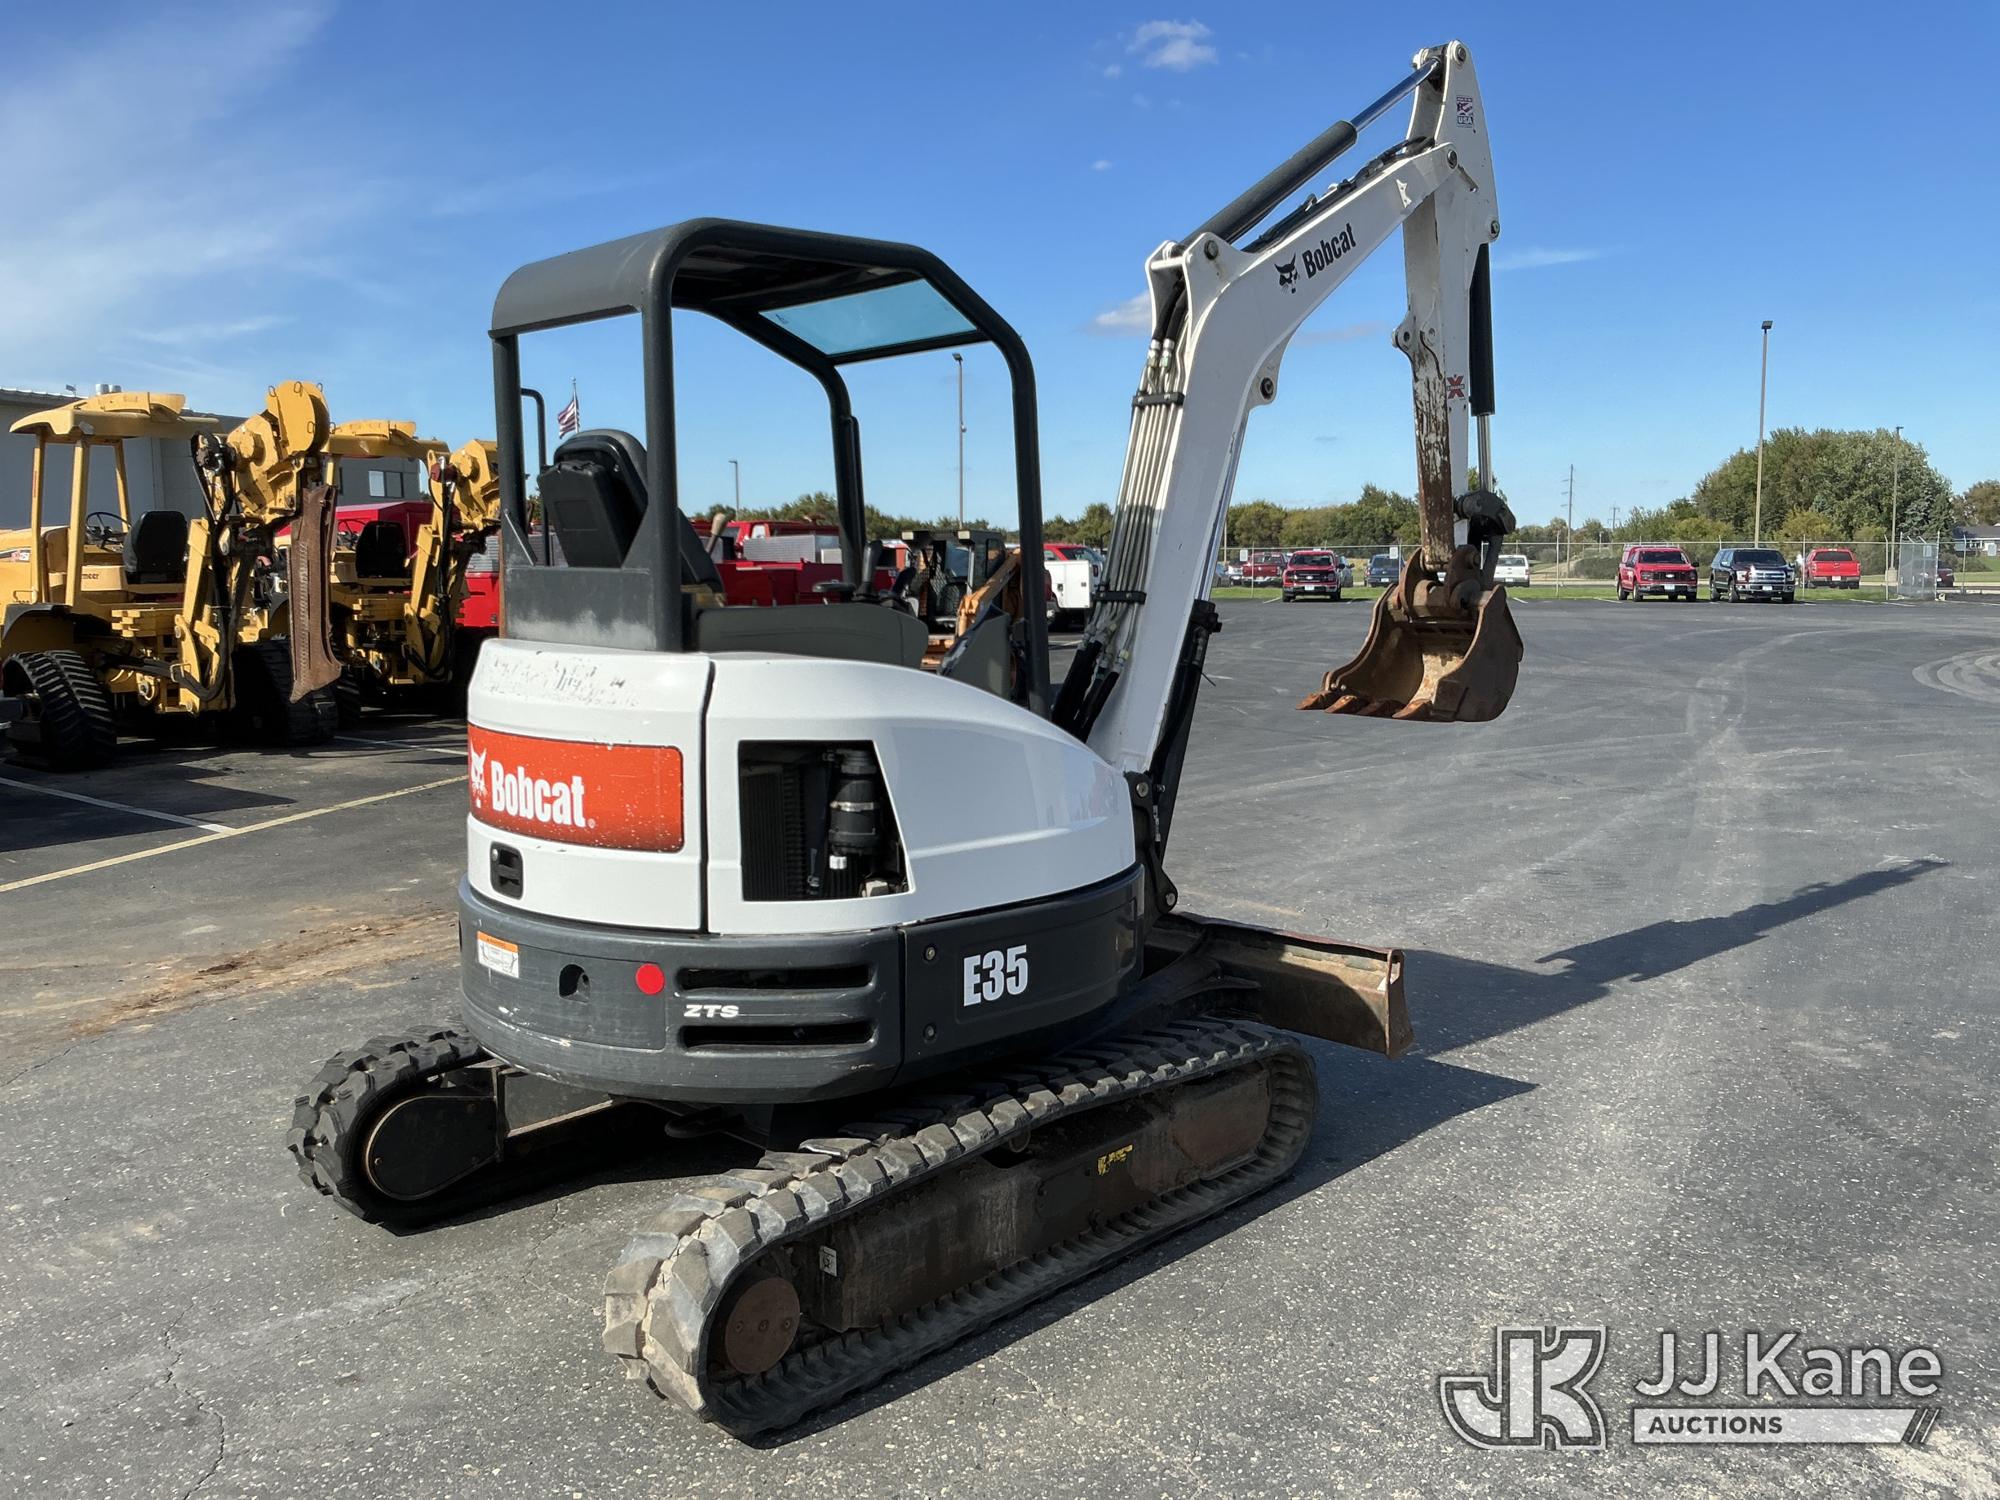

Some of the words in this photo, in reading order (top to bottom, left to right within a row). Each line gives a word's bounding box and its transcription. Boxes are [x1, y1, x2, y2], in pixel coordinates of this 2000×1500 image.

[1301, 222, 1357, 279] Bobcat
[490, 760, 587, 829] Bobcat
[963, 944, 1029, 1007] E35
[683, 1003, 739, 1018] ZTS
